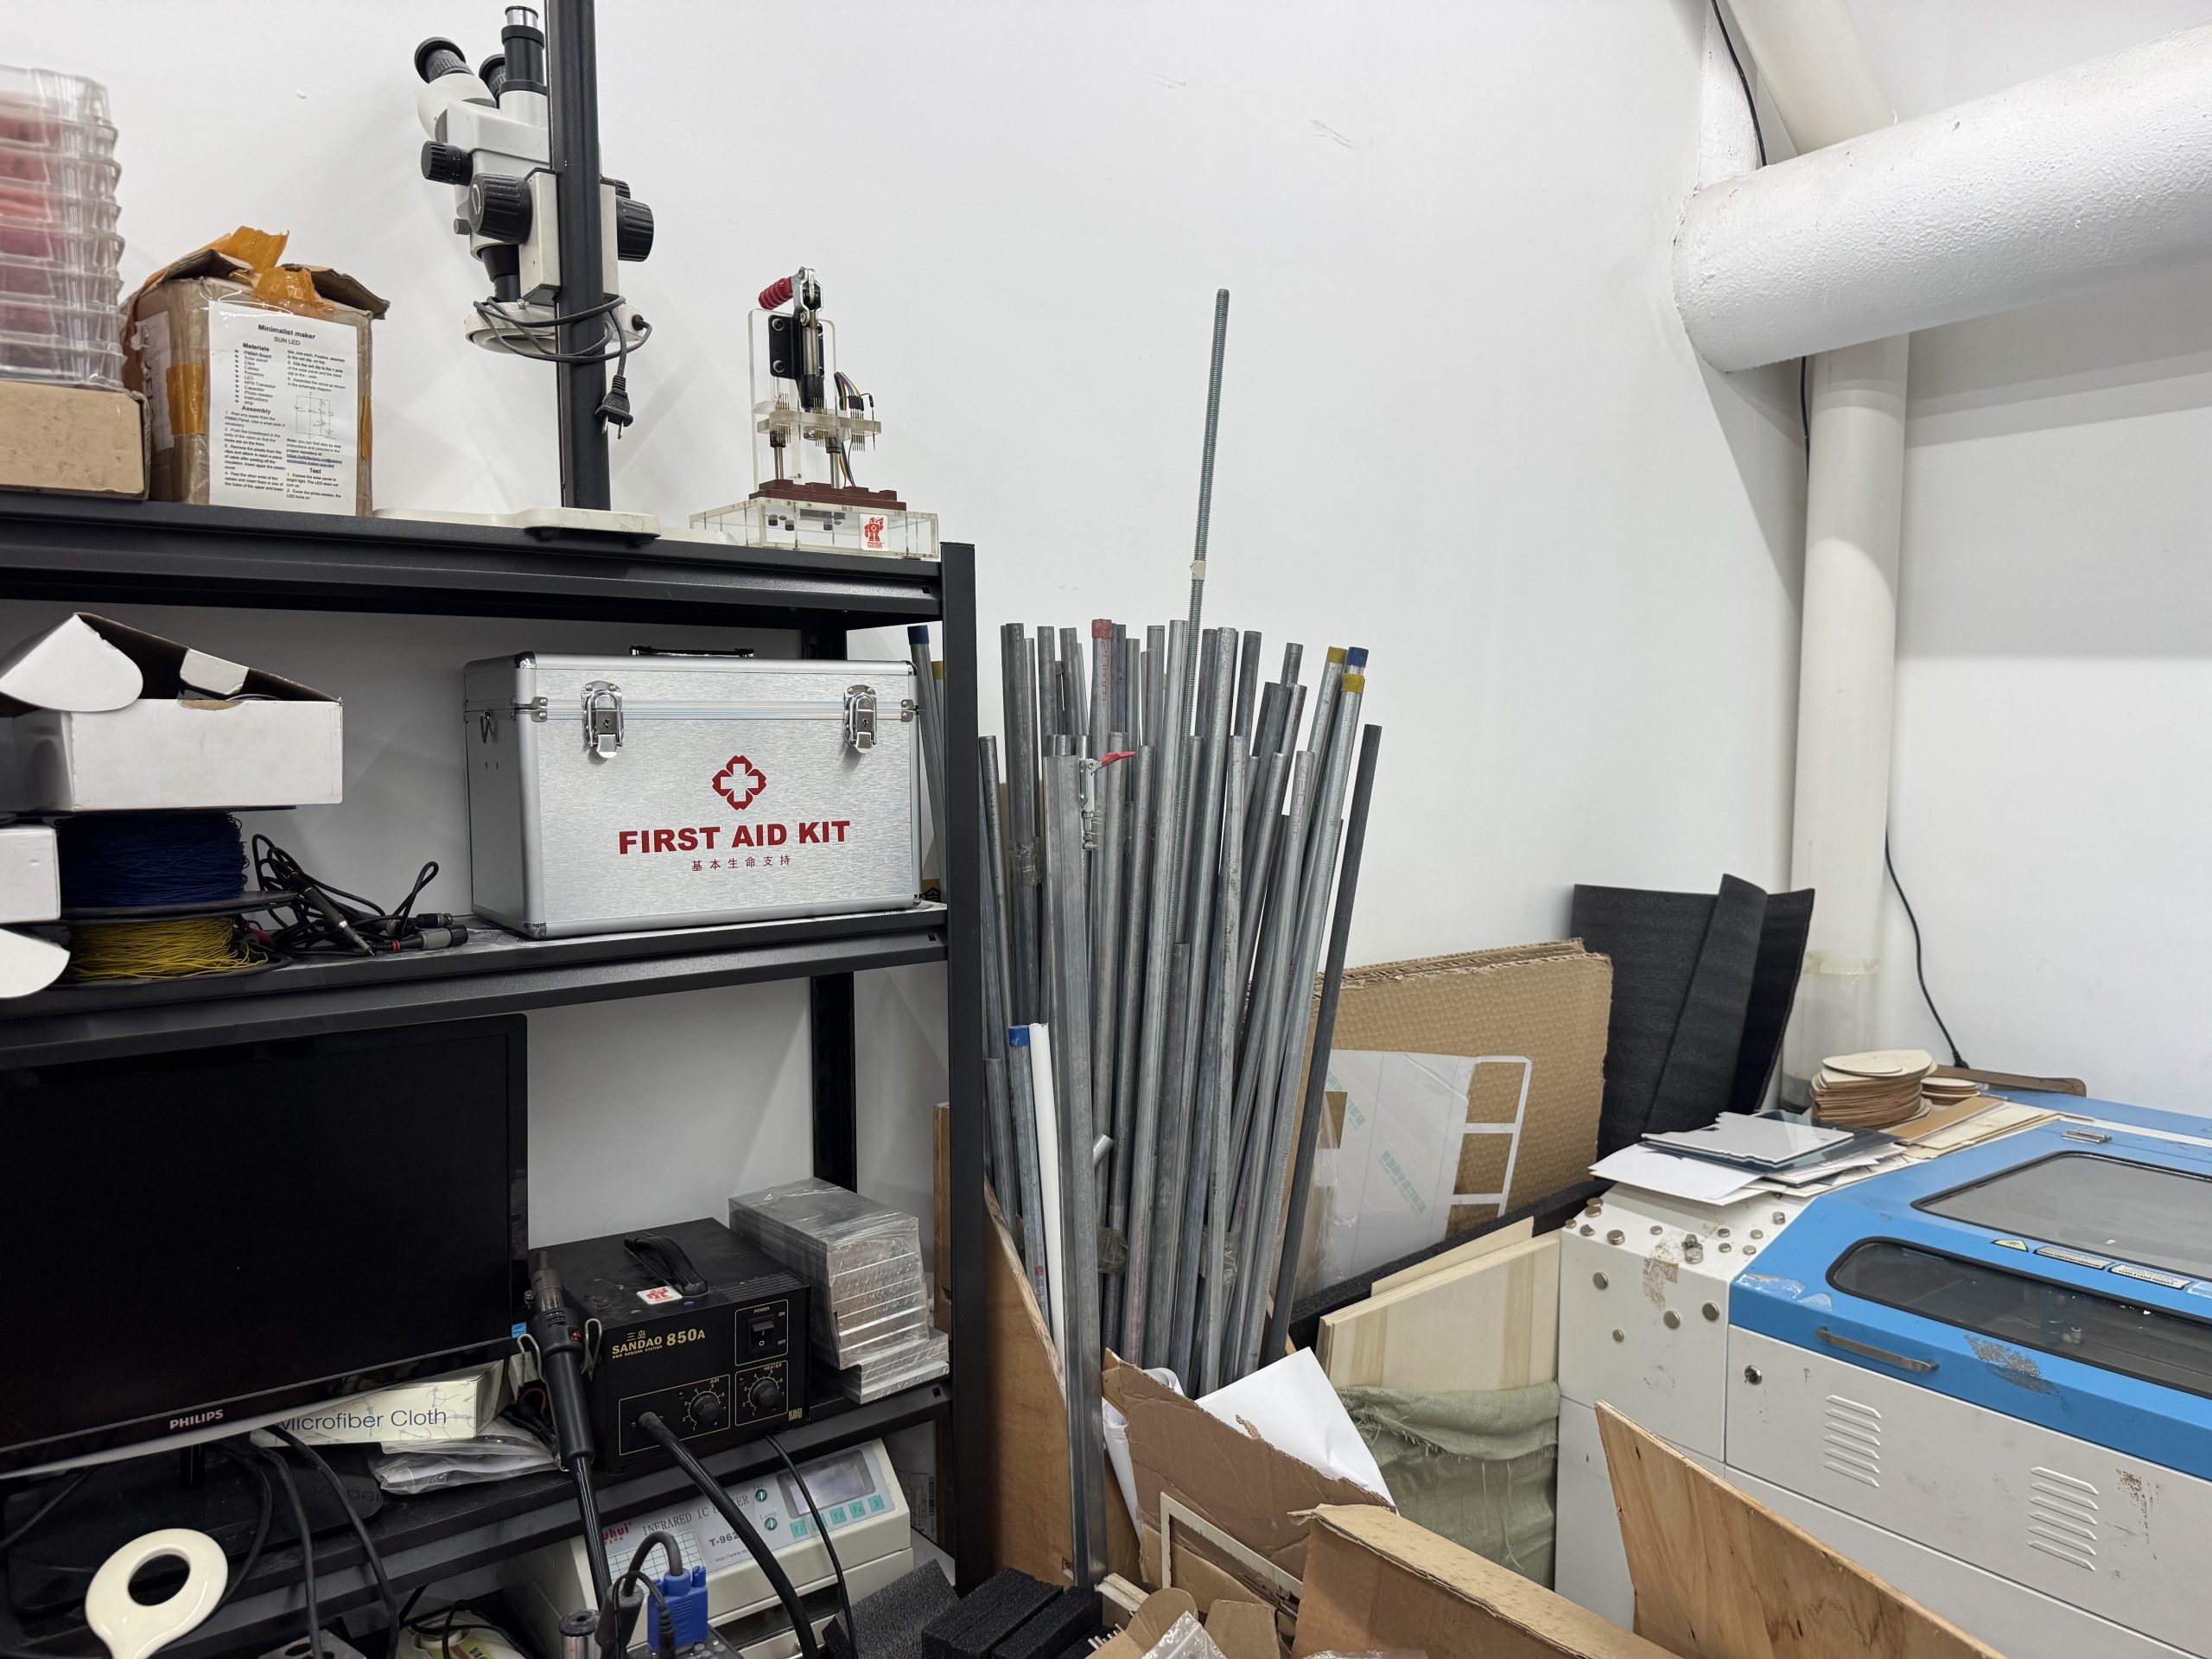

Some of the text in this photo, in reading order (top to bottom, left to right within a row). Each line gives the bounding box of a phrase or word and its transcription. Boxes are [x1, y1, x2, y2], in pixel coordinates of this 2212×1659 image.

[258, 324, 293, 336] Minimalist
[243, 343, 270, 352] Materials
[242, 405, 271, 415] Assembly
[619, 821, 850, 855] FIRST AID KIT
[691, 855, 791, 872] 基本生命支持
[612, 1328, 706, 1355] SANDAO 850A
[763, 1363, 783, 1371] HEATER
[169, 1409, 224, 1430] PHILIPS
[391, 1408, 447, 1427] Cloth
[642, 1506, 709, 1536] INFRARED IC
[760, 1510, 777, 1520] Lamp
